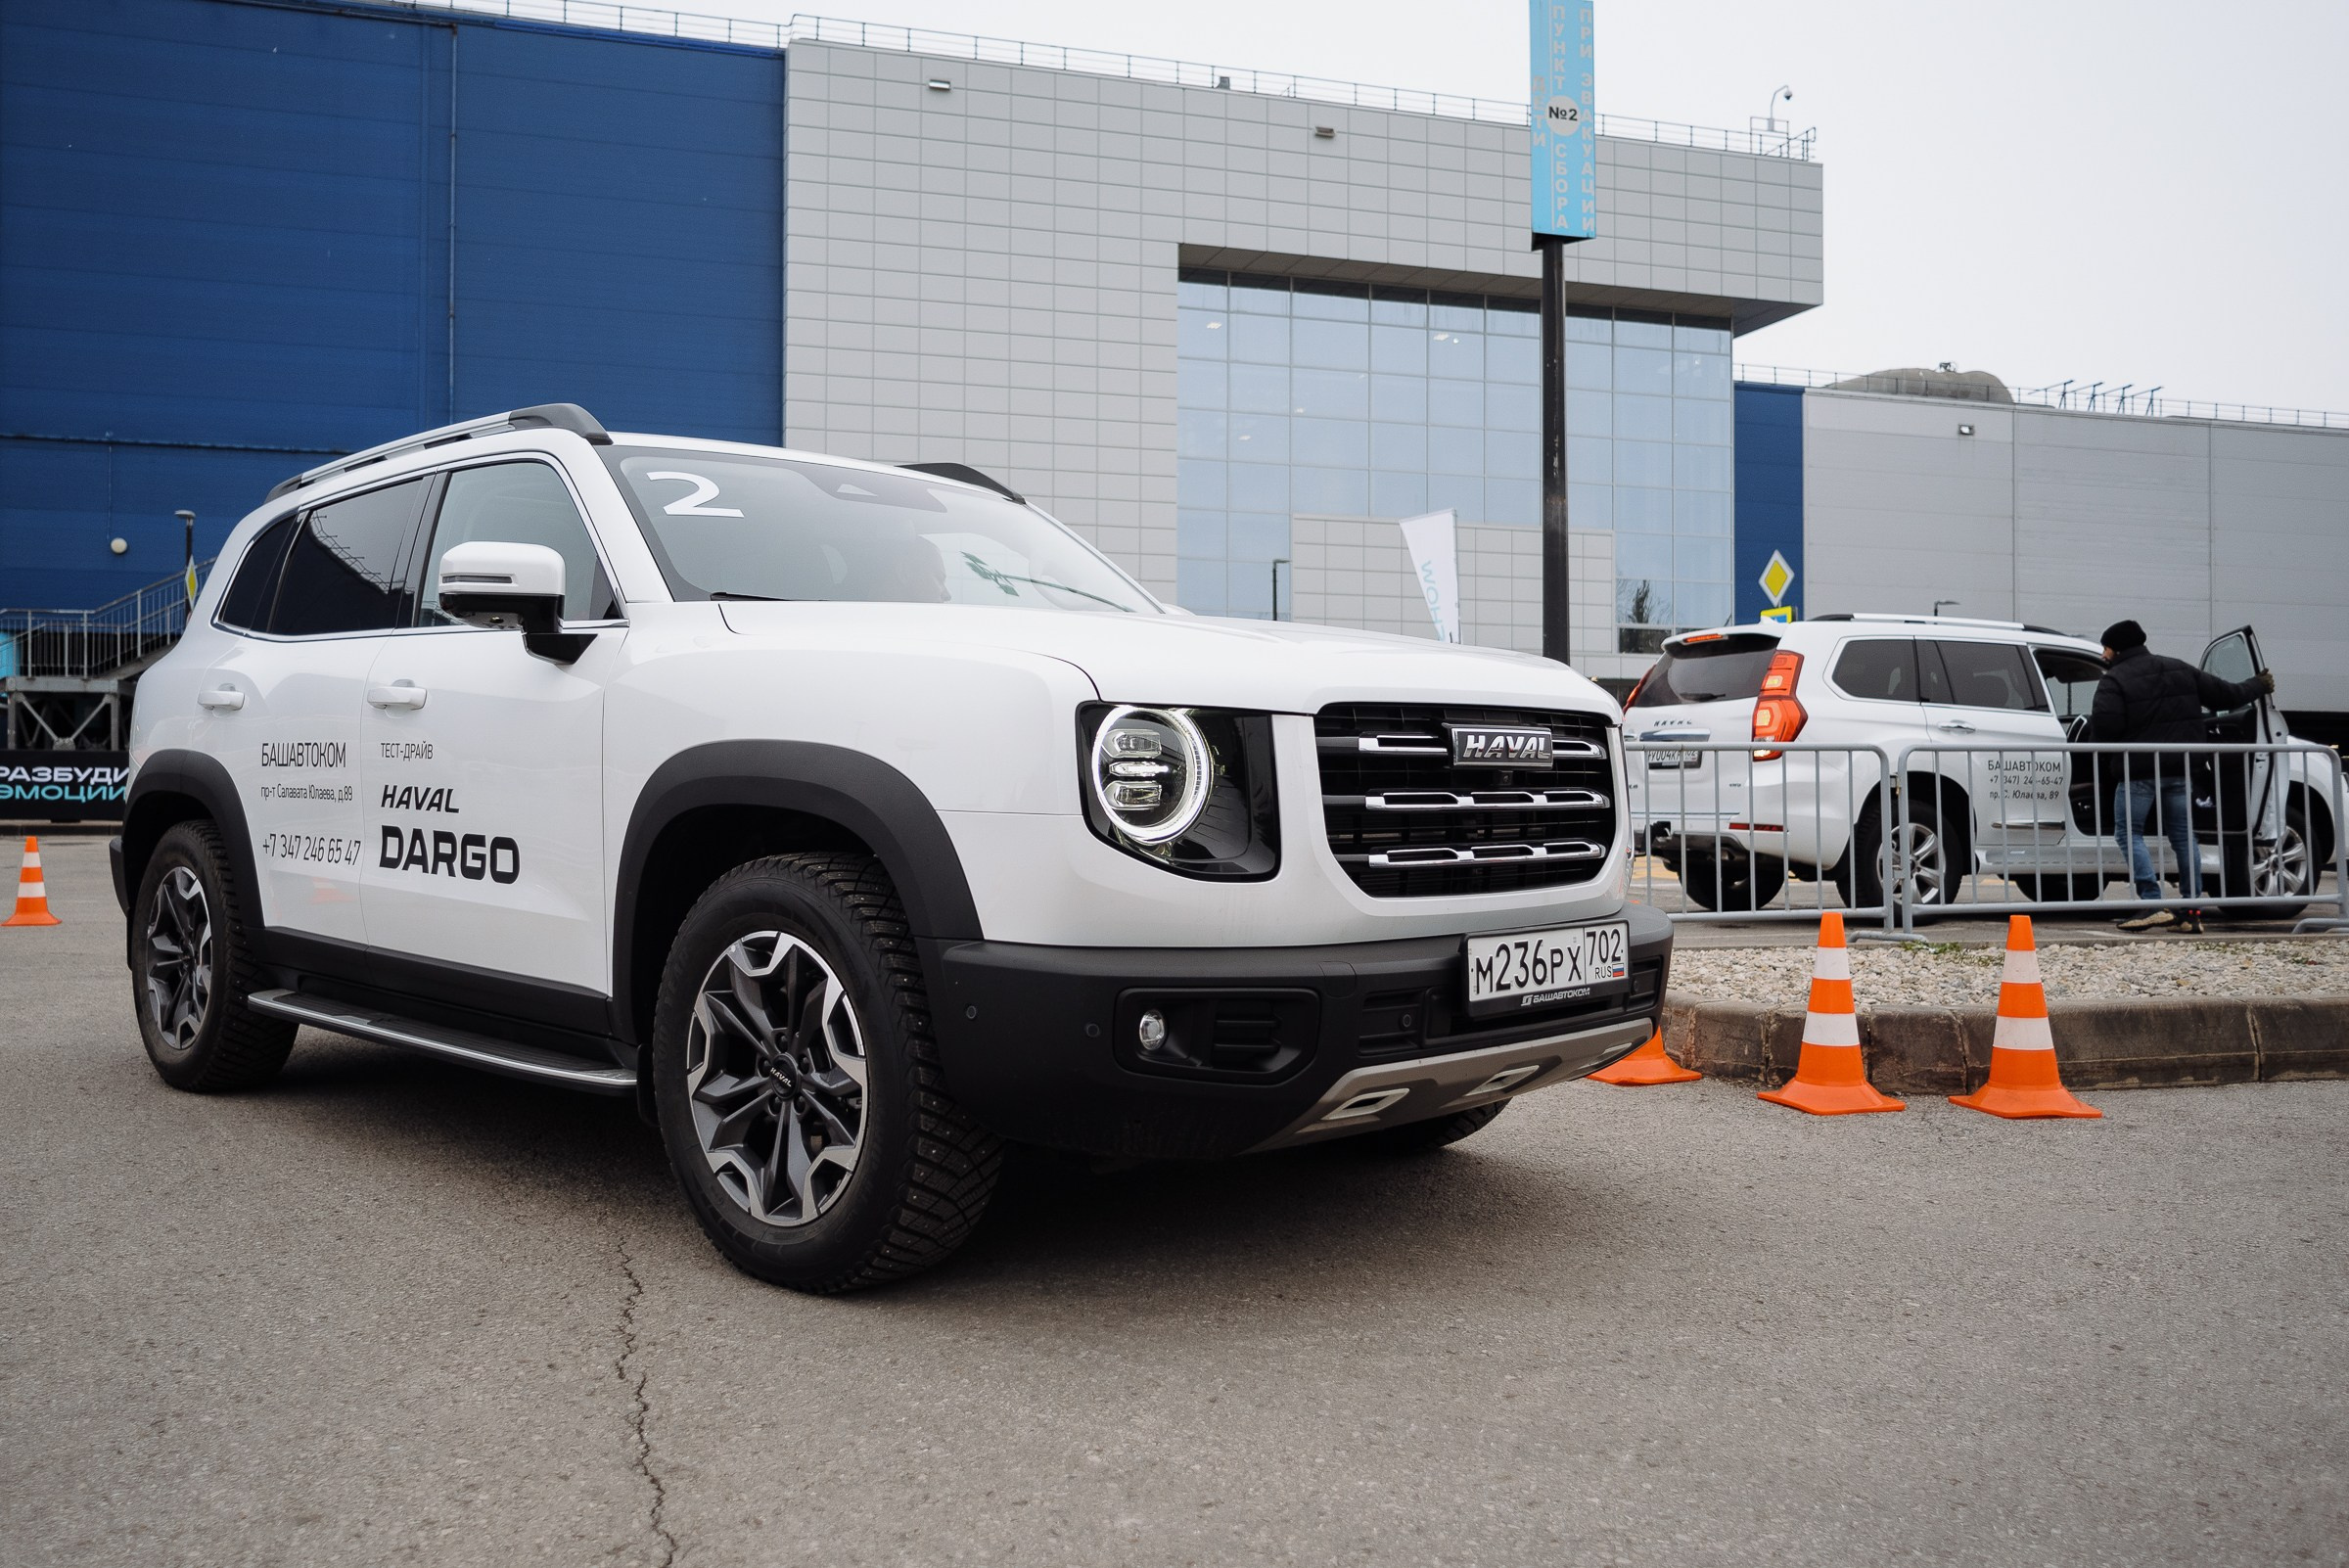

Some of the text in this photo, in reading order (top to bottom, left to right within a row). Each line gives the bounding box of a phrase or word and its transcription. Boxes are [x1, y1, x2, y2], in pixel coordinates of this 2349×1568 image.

[1548, 106, 1578, 121] №2
[1552, 5, 1568, 230] ПУНКТ СБОРА
[1579, 8, 1594, 232] ПРИ ЭВАКУАЦИИ
[646, 471, 745, 519] 2
[261, 742, 346, 768] БАШАВТОКОМ
[381, 741, 434, 761] ТЕСТ-ДРАЙВ
[1462, 734, 1550, 760] HAVAL
[2003, 774, 2020, 785] 347)
[0, 784, 126, 804] ЭМОЦИИ
[261, 786, 276, 801] пр-т
[277, 783, 308, 800] Салавата
[309, 784, 337, 803] Юлаева,
[381, 784, 460, 813] HAVAL
[262, 833, 361, 865] +7 347 246 65 47
[379, 824, 521, 885] DARGO
[1586, 928, 1622, 966] 702
[1594, 966, 1612, 979] RUS
[1533, 987, 1590, 1003] БАШАВТОКОМ
[770, 1067, 792, 1087] HAVAL
